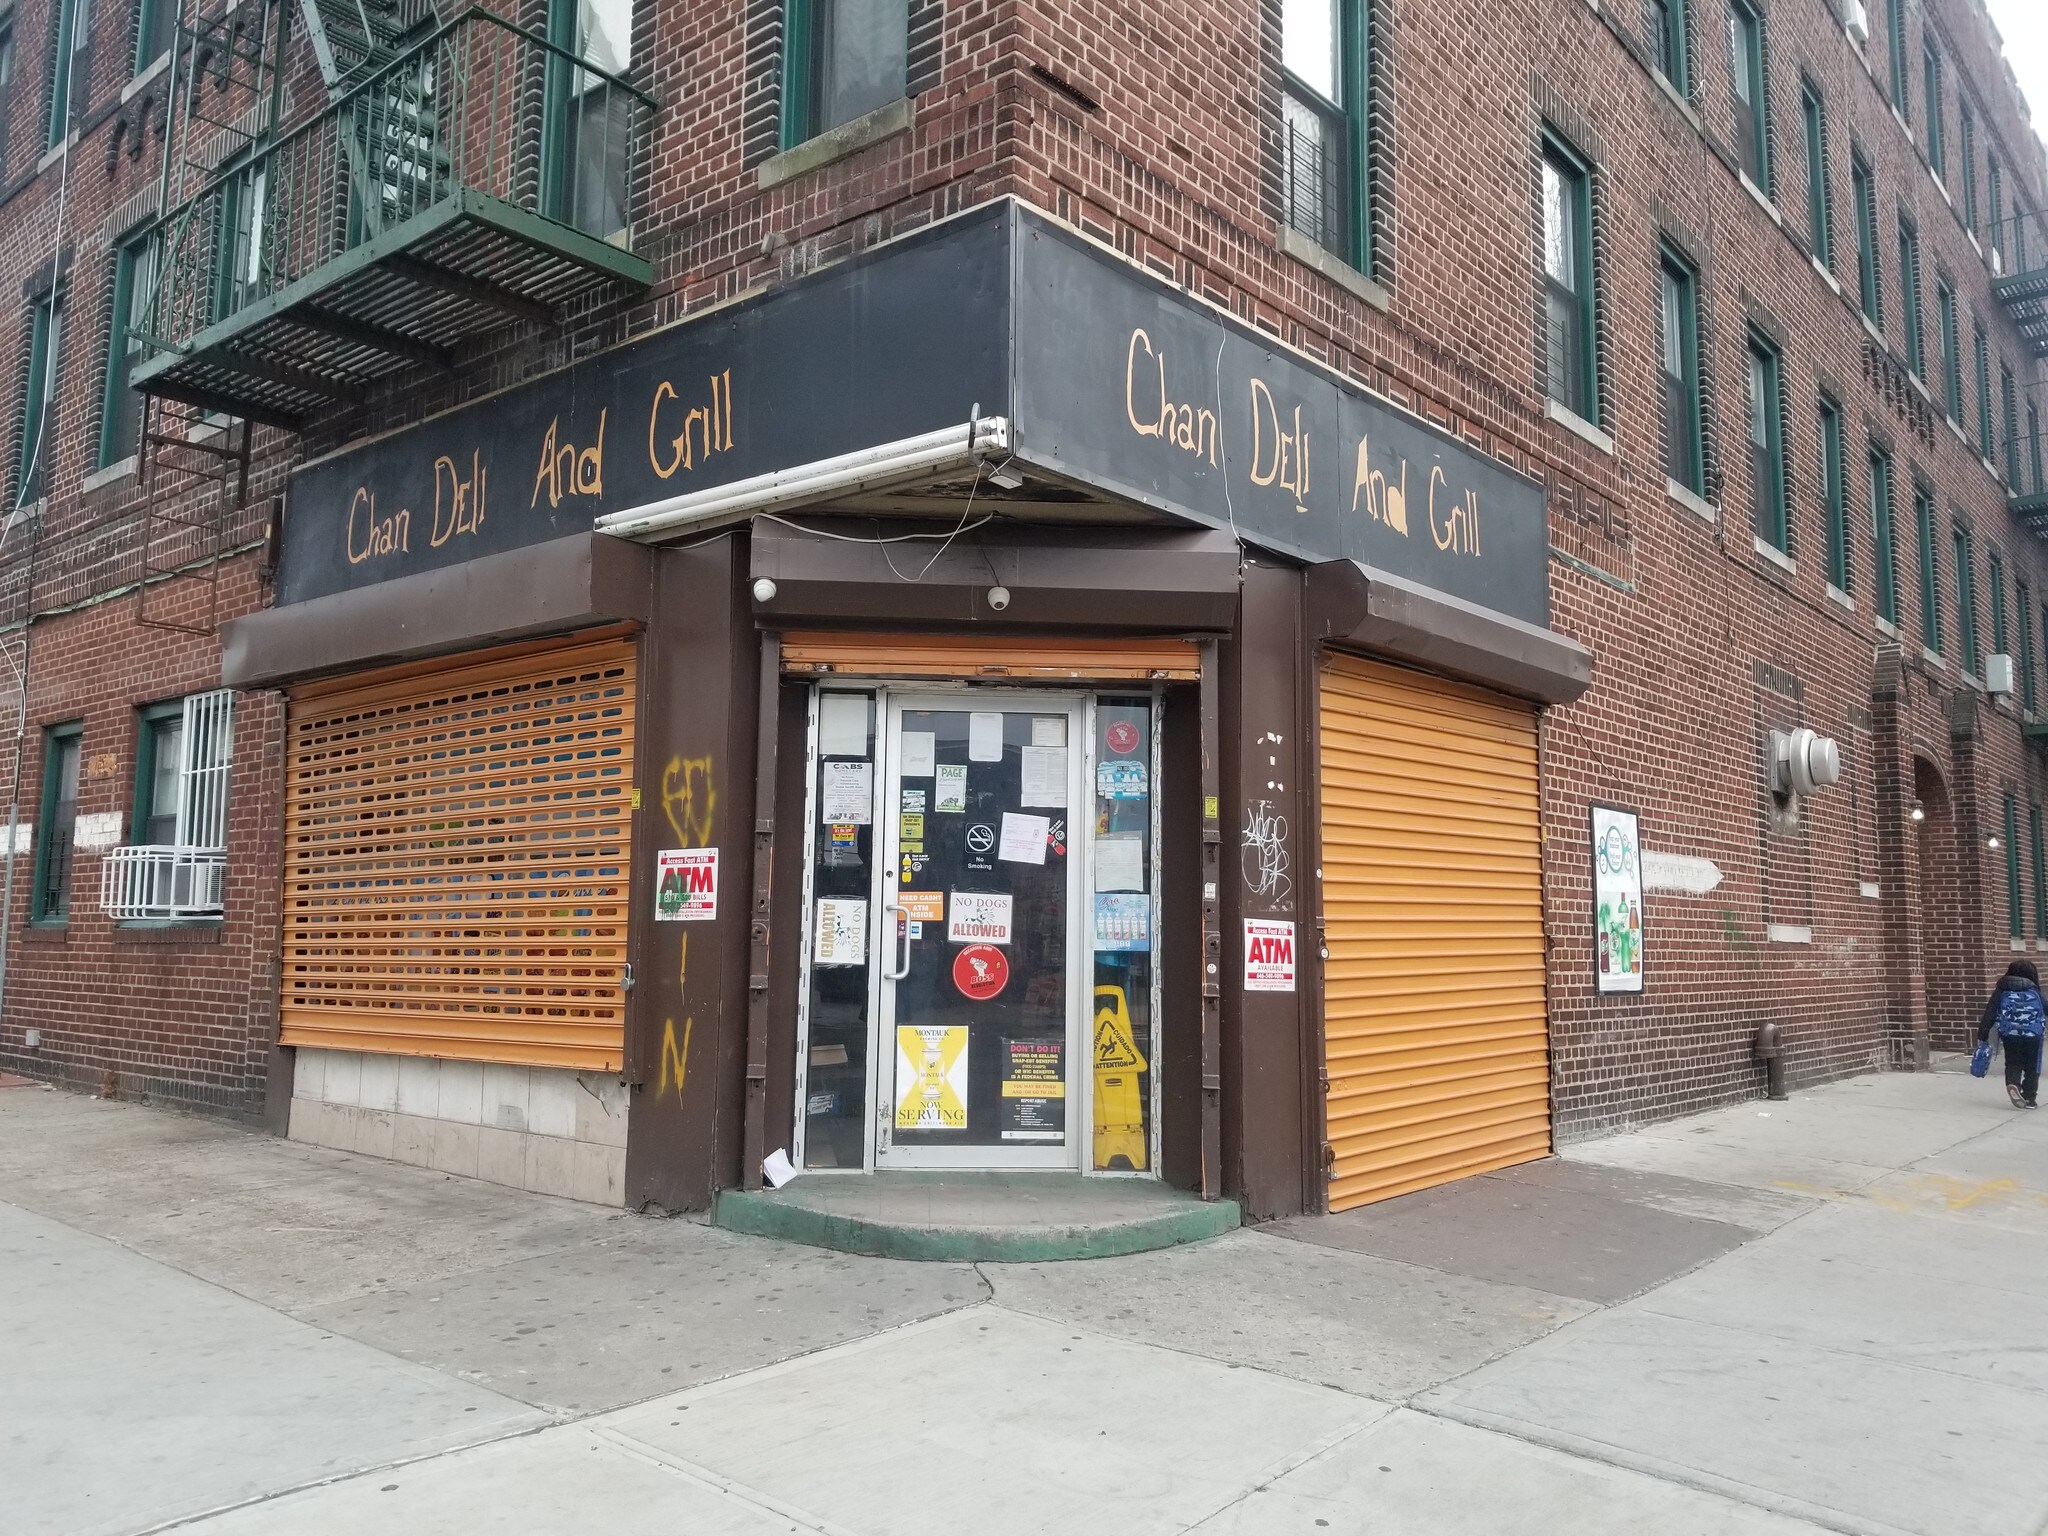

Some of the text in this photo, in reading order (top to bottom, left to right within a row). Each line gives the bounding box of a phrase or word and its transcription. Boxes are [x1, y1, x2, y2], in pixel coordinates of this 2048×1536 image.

[1126, 327, 1218, 469] Chan
[1352, 433, 1409, 537] And
[1428, 465, 1482, 557] Grill
[347, 486, 410, 564] Chan
[531, 406, 607, 508] And
[648, 367, 735, 480] Grill
[942, 768, 963, 777] PAGE
[660, 866, 713, 893] ATM
[955, 898, 1008, 908] NO DOGS
[821, 903, 835, 958] ALLOWED
[851, 905, 862, 958] NO DOGS
[953, 923, 1006, 937] ALLOWED
[1248, 937, 1292, 964] ATM
[971, 973, 994, 984] BOSS
[1113, 1029, 1133, 1054] CUIDADO
[898, 1110, 964, 1120] SERVING
